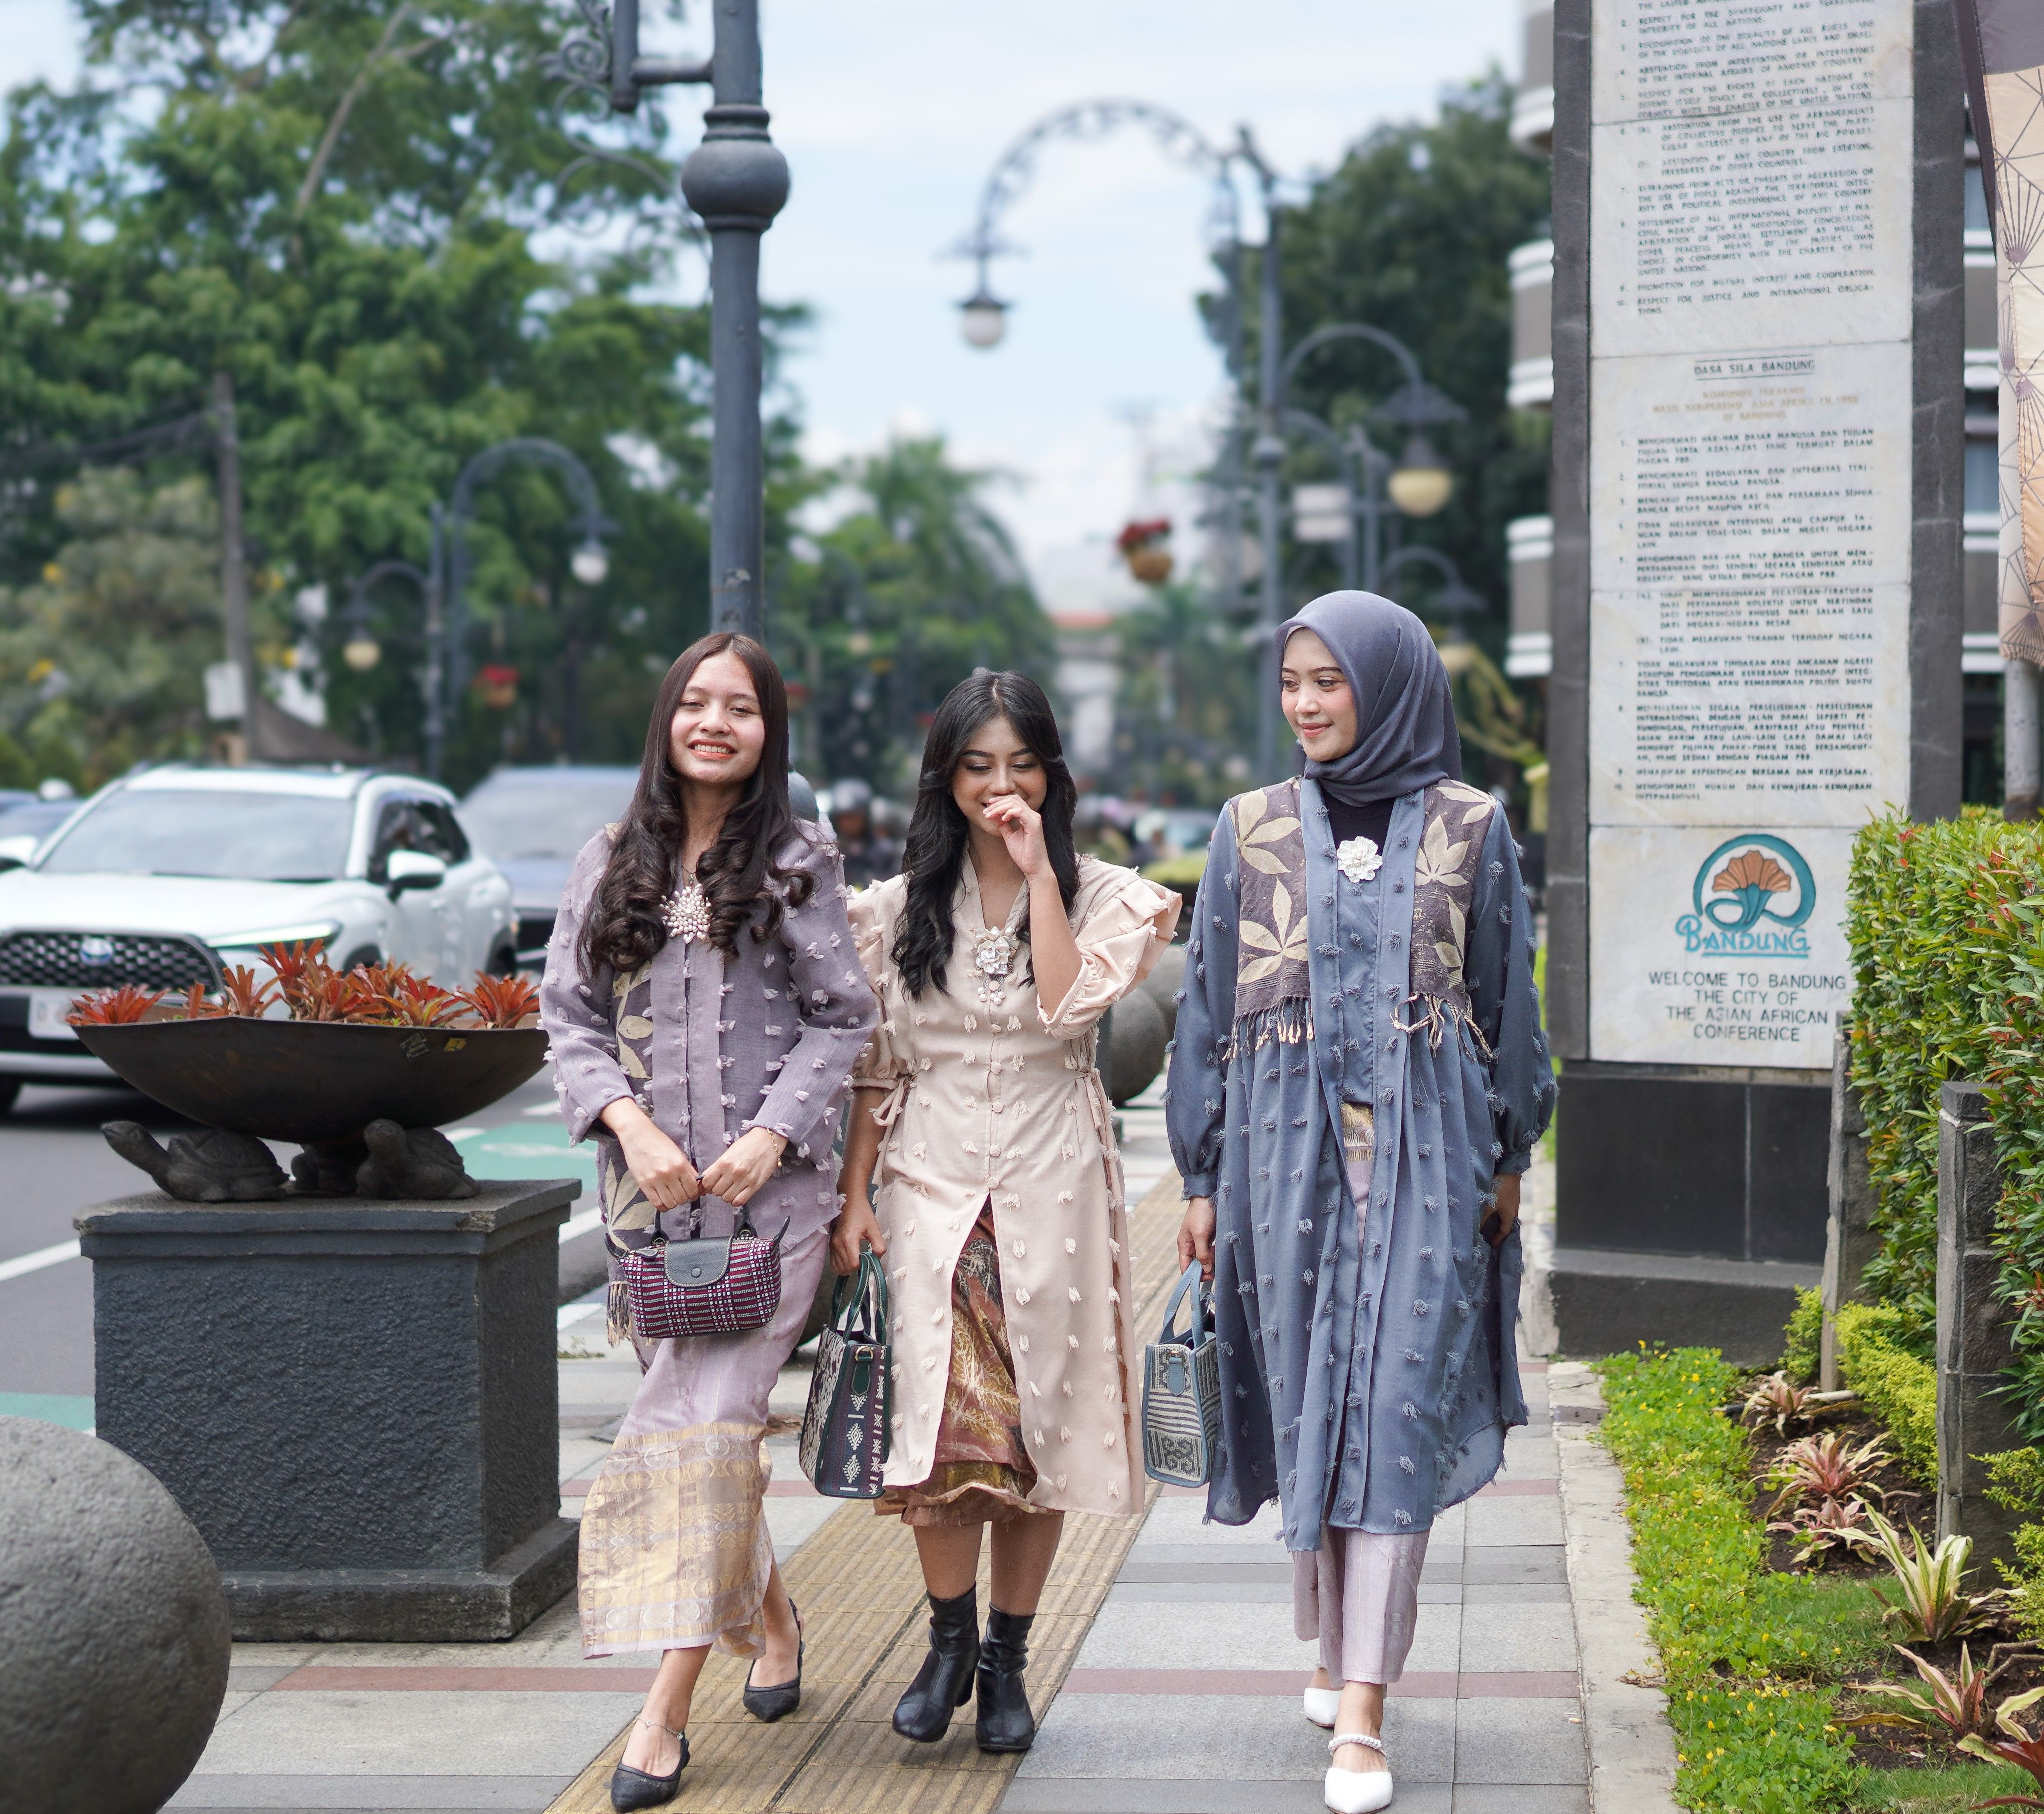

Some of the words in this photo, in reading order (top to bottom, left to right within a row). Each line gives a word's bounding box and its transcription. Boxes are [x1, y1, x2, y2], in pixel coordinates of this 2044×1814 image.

[1694, 364, 1721, 375] DASA
[1730, 363, 1753, 373] SILA
[1762, 359, 1814, 371] BANDUNG
[1649, 972, 1728, 987] WELCOME
[1737, 973, 1759, 988] TO
[1769, 974, 1846, 990] BANDUNG
[1694, 989, 1724, 1004] THE
[1732, 990, 1768, 1005] CITY
[1777, 991, 1799, 1005] OF
[1665, 1006, 1696, 1021] THE
[1705, 1007, 1751, 1022] ASIAN
[1760, 1009, 1828, 1025] AFRICAN
[1693, 1024, 1801, 1042] CONFERENCE
